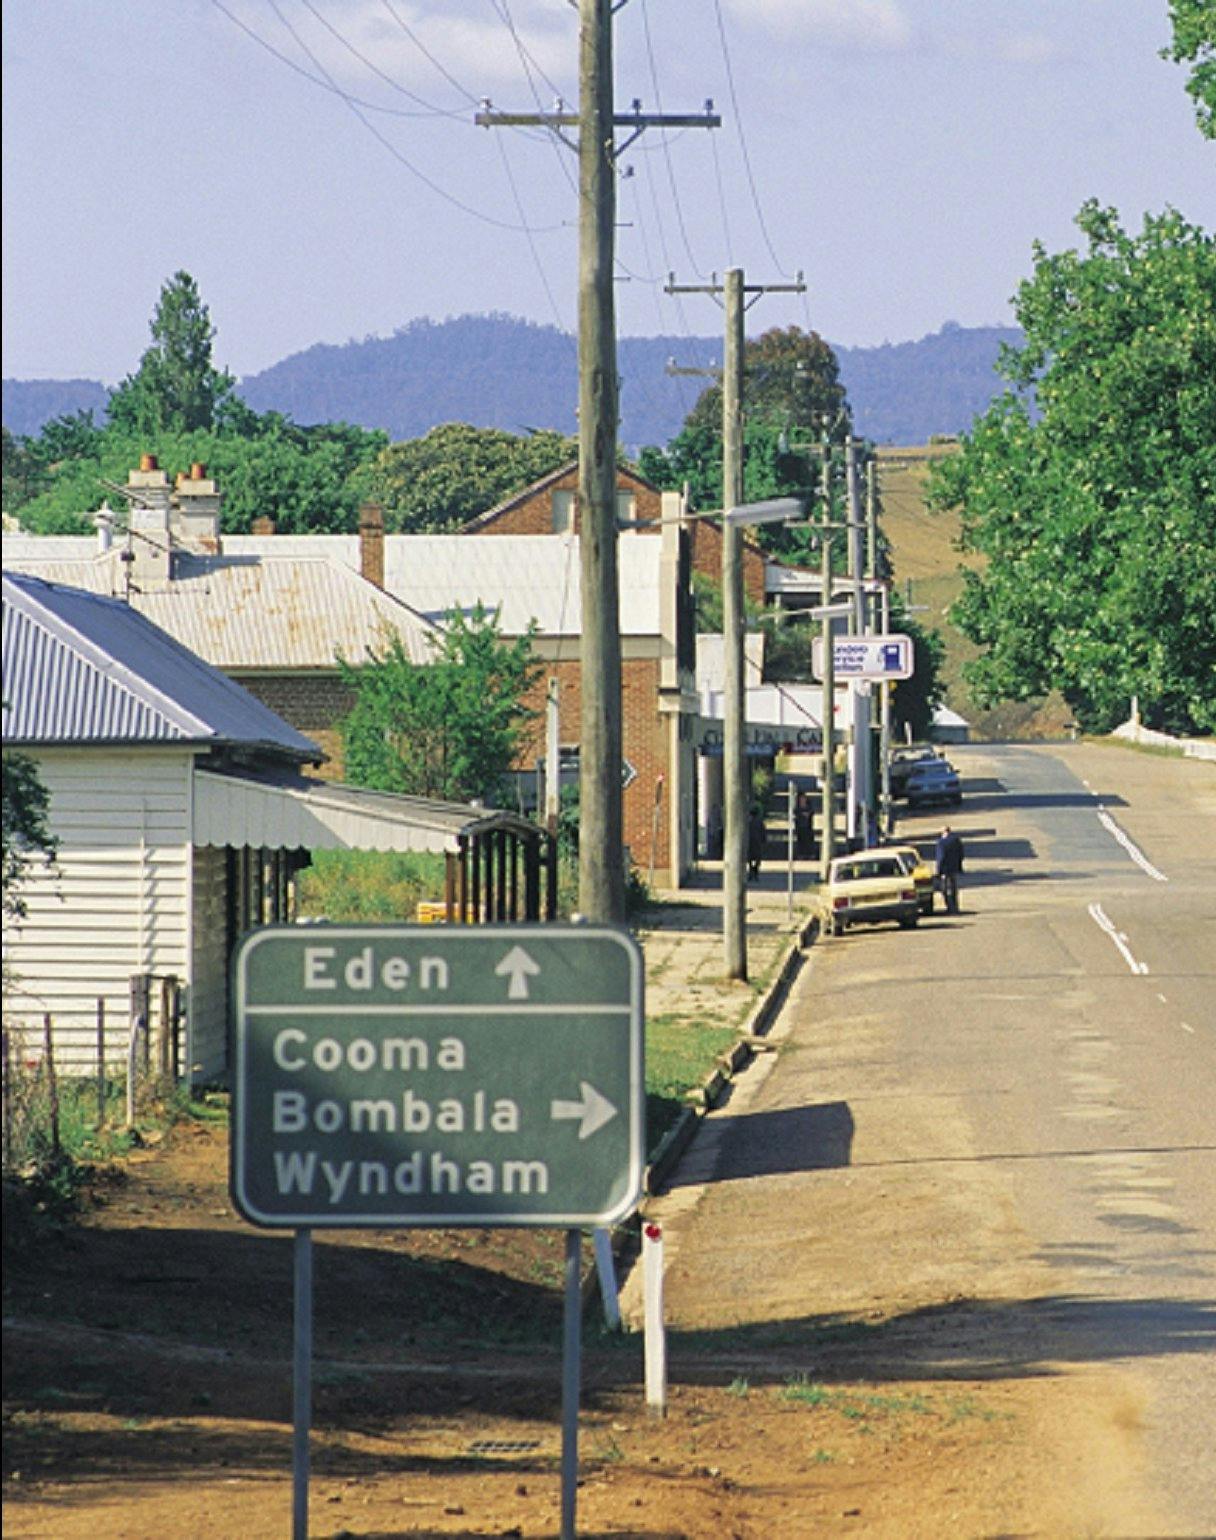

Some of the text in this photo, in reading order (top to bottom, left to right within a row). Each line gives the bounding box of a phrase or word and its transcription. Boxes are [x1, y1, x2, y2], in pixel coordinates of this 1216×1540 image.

[304, 946, 449, 990] Eden
[274, 1028, 466, 1071] Cooma
[273, 1089, 521, 1133] Bombala
[273, 1151, 549, 1203] Wyndham
